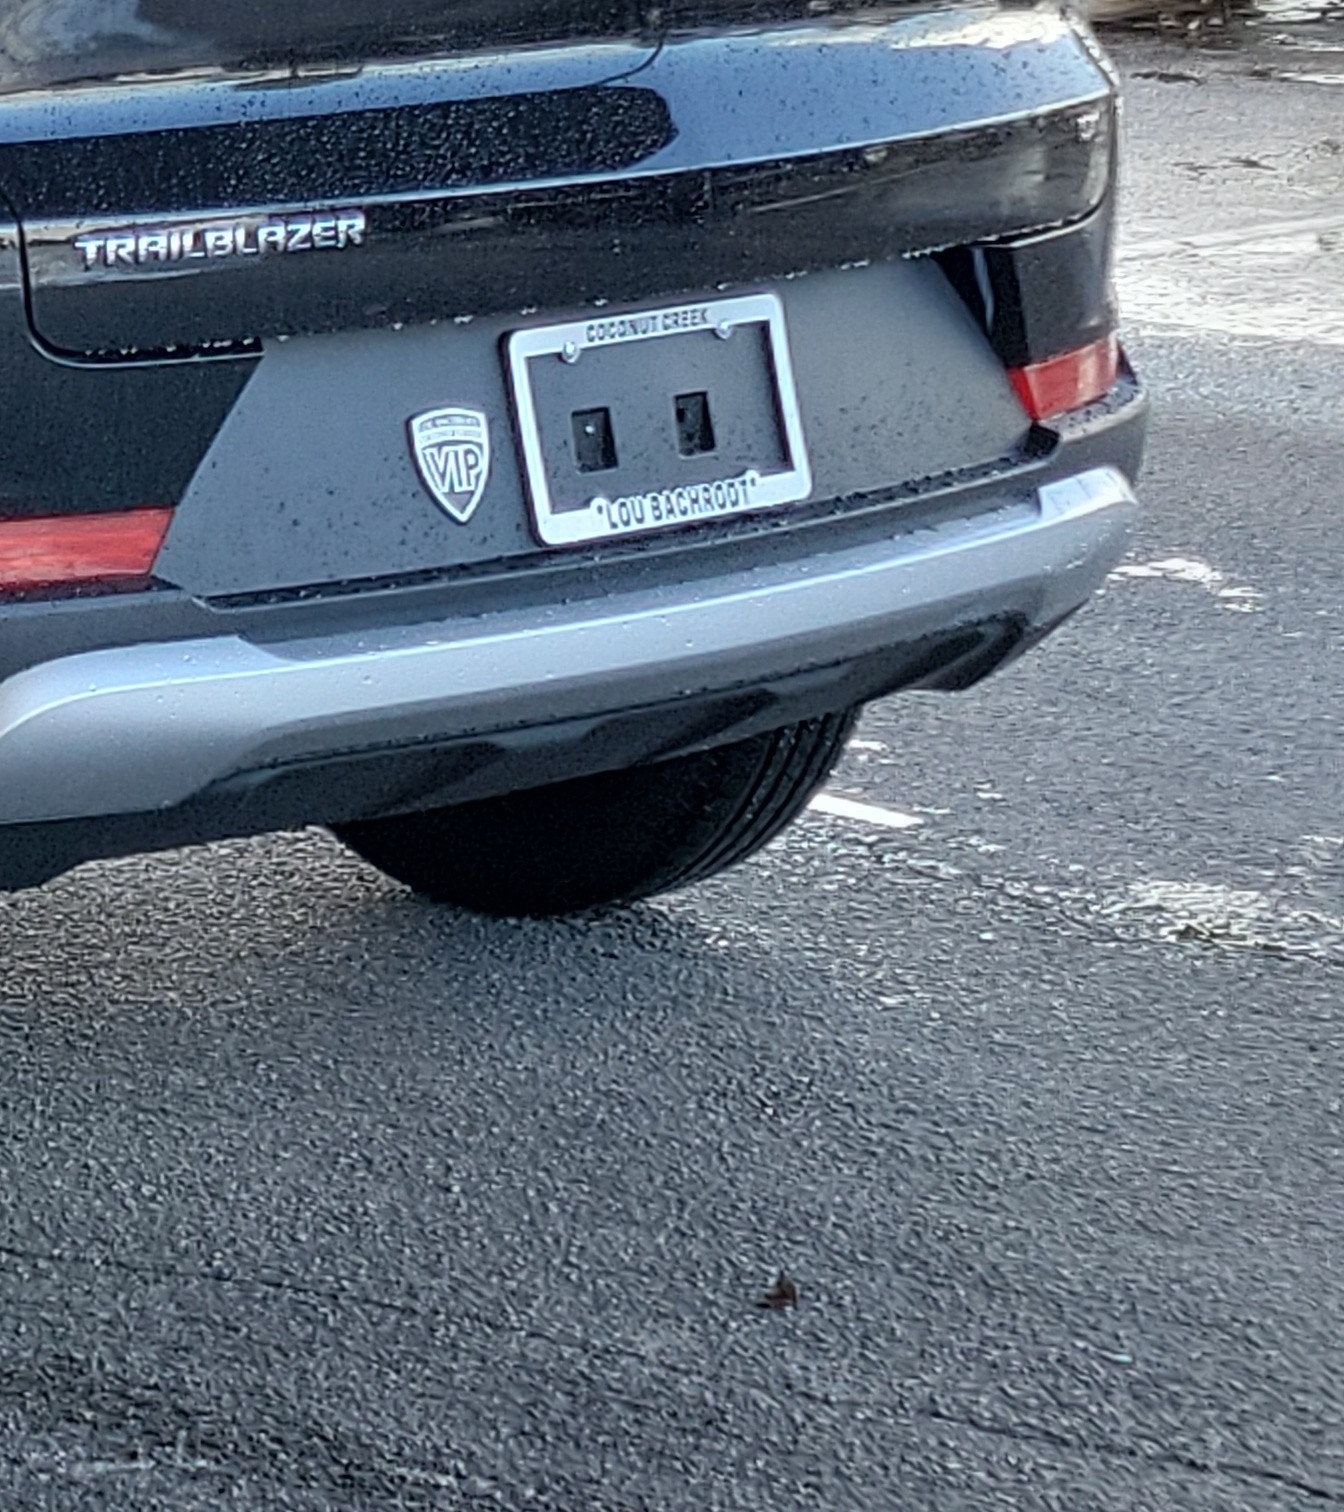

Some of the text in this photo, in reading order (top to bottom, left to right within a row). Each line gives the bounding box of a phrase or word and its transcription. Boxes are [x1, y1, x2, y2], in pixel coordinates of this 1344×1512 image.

[74, 212, 365, 268] TRAILBLAZER
[586, 308, 709, 343] COCONUT CREEK
[422, 445, 482, 494] VIP
[606, 498, 645, 530] LOU
